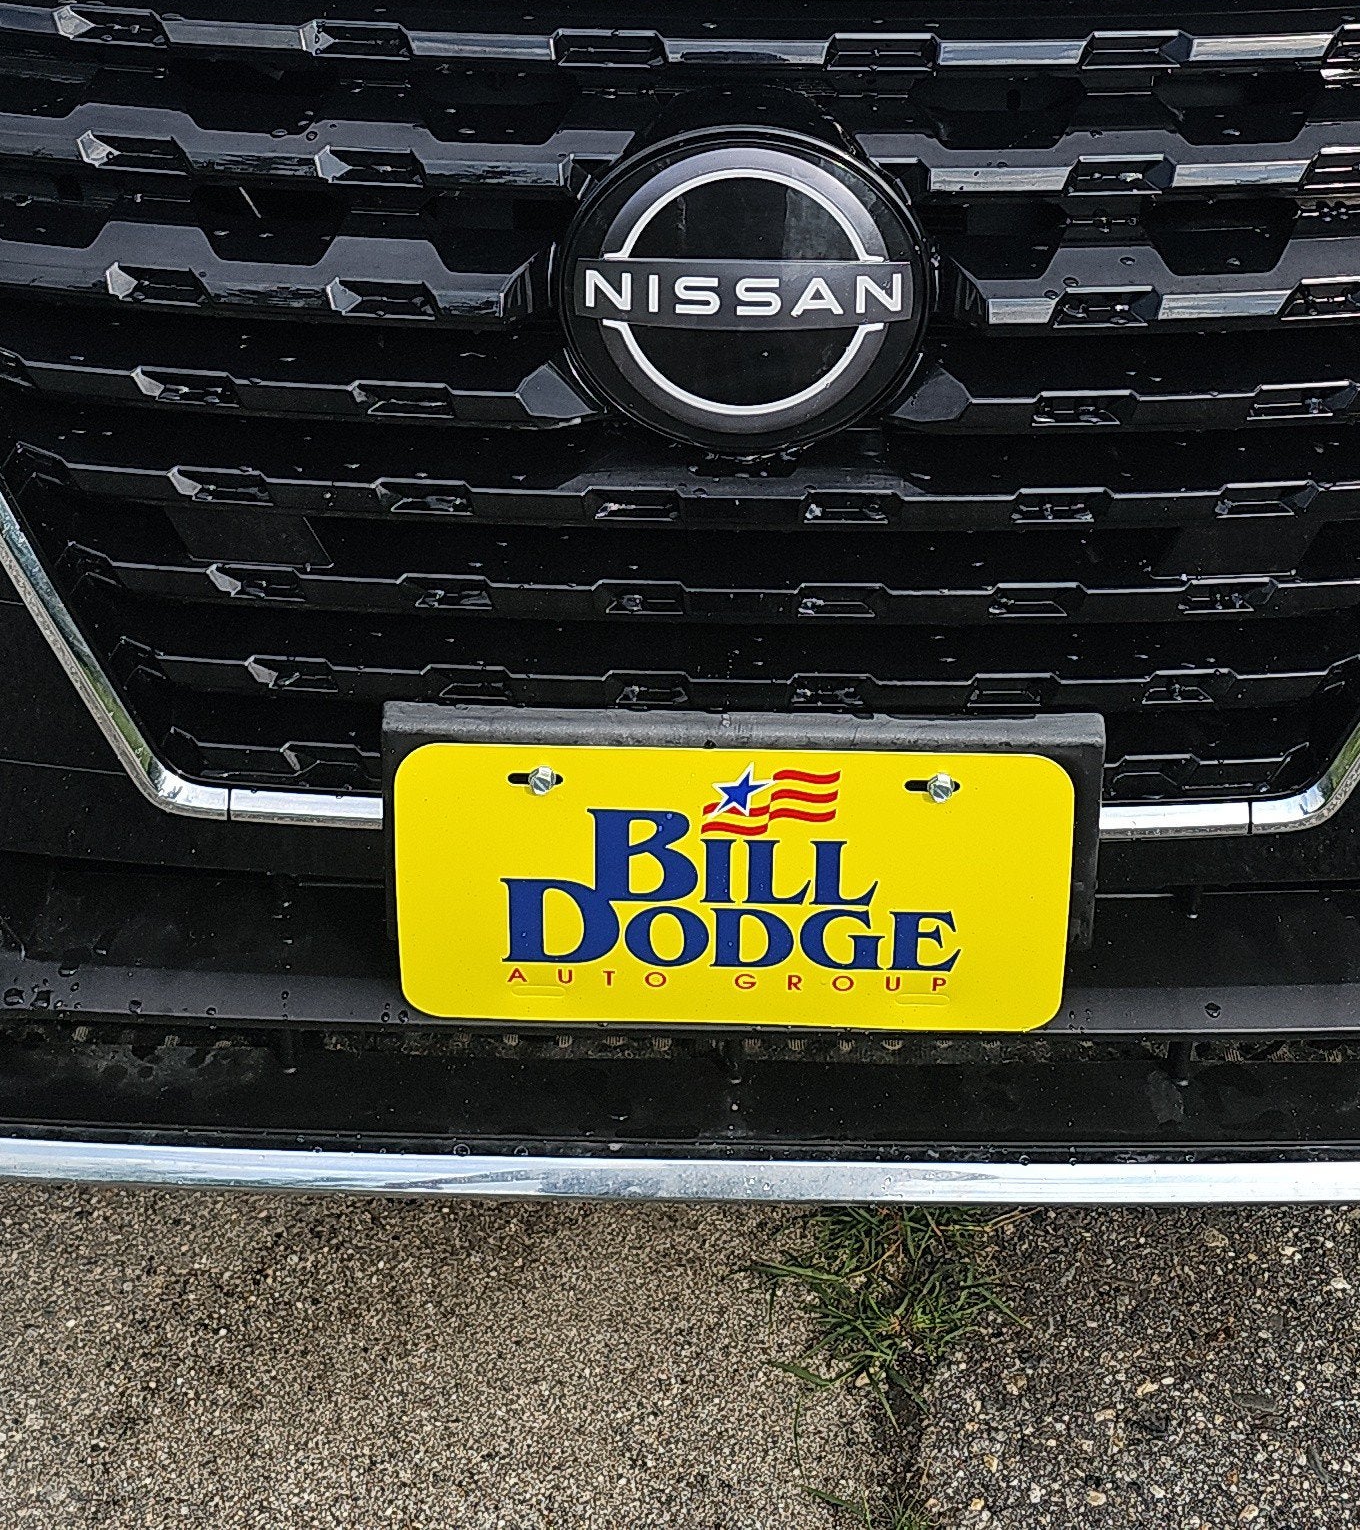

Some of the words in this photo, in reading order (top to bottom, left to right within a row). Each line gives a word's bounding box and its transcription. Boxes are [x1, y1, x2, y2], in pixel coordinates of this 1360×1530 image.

[584, 268, 903, 317] NISSAN
[587, 807, 879, 906] BILL
[500, 877, 963, 973] DODGE
[506, 967, 668, 988] AUTO
[734, 972, 947, 993] GROUP
